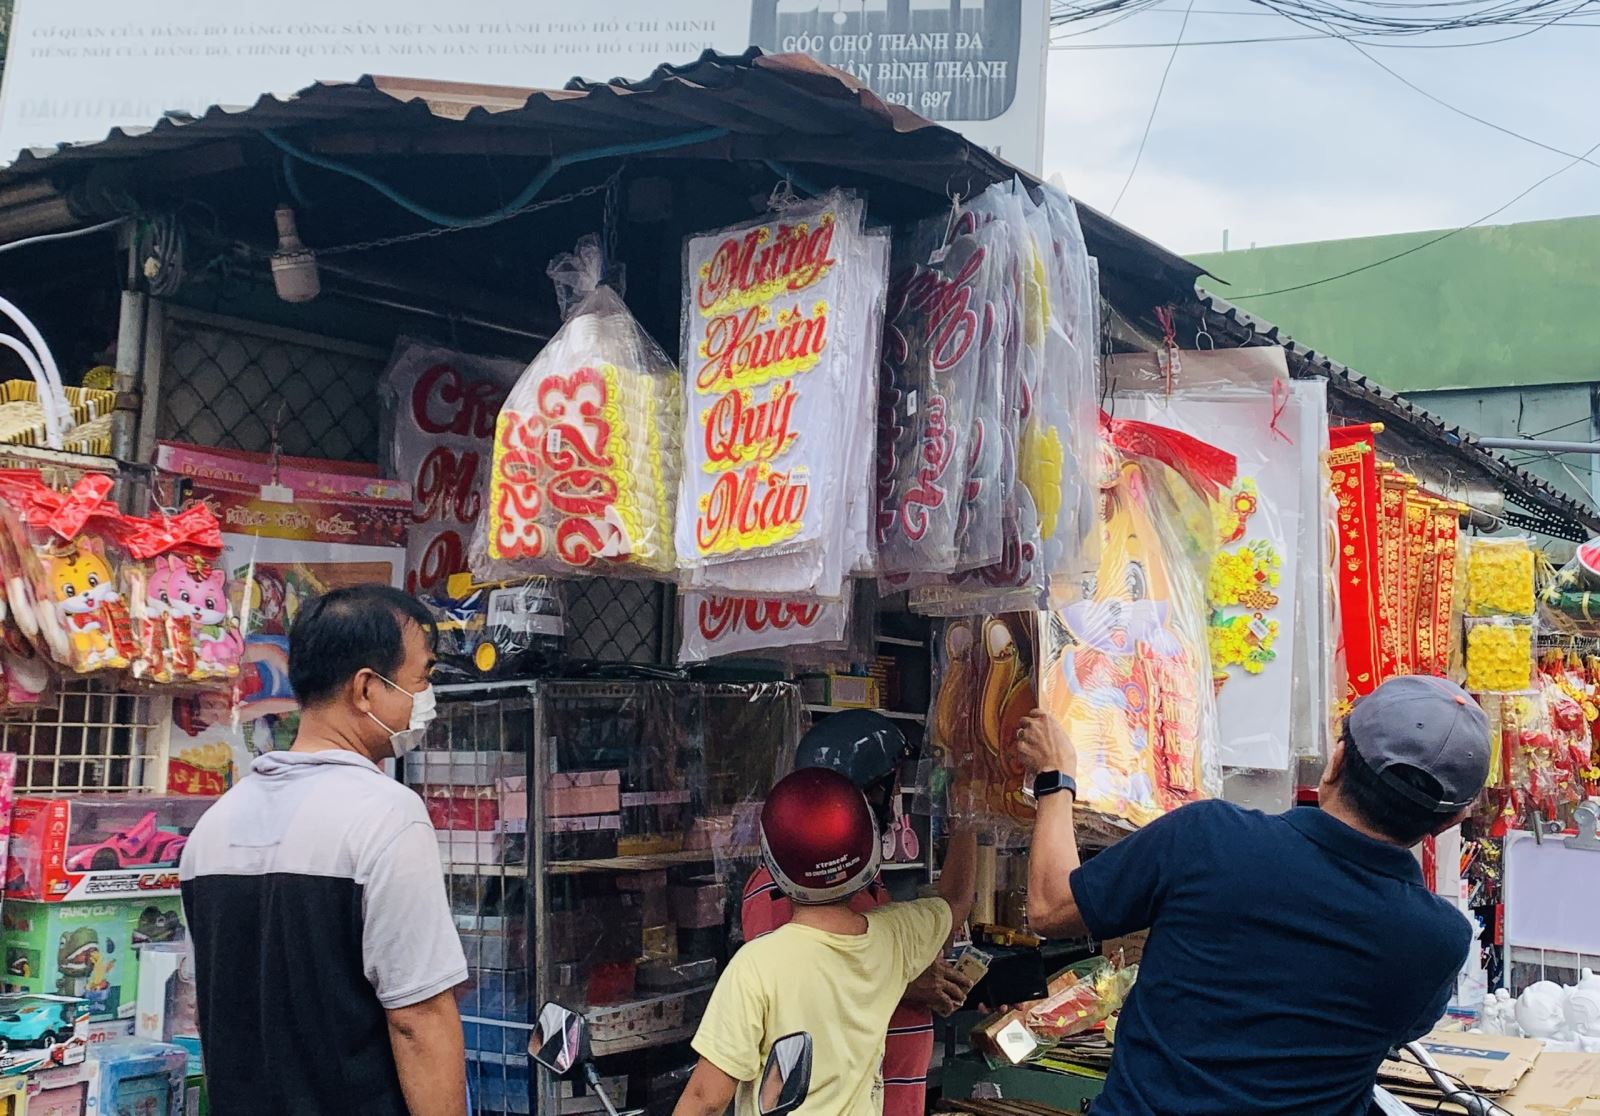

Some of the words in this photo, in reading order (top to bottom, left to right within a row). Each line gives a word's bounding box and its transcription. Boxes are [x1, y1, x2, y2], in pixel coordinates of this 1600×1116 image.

[665, 19, 717, 32] MINH
[782, 30, 824, 53] GÓC
[829, 32, 873, 55] CHỢ
[878, 33, 949, 51] THANH
[955, 32, 984, 49] ĐA
[877, 58, 928, 80] BÌNH
[935, 61, 1008, 82] THẠNH
[921, 91, 952, 107] 697
[696, 303, 828, 389] Xuân
[704, 379, 799, 463] Quý
